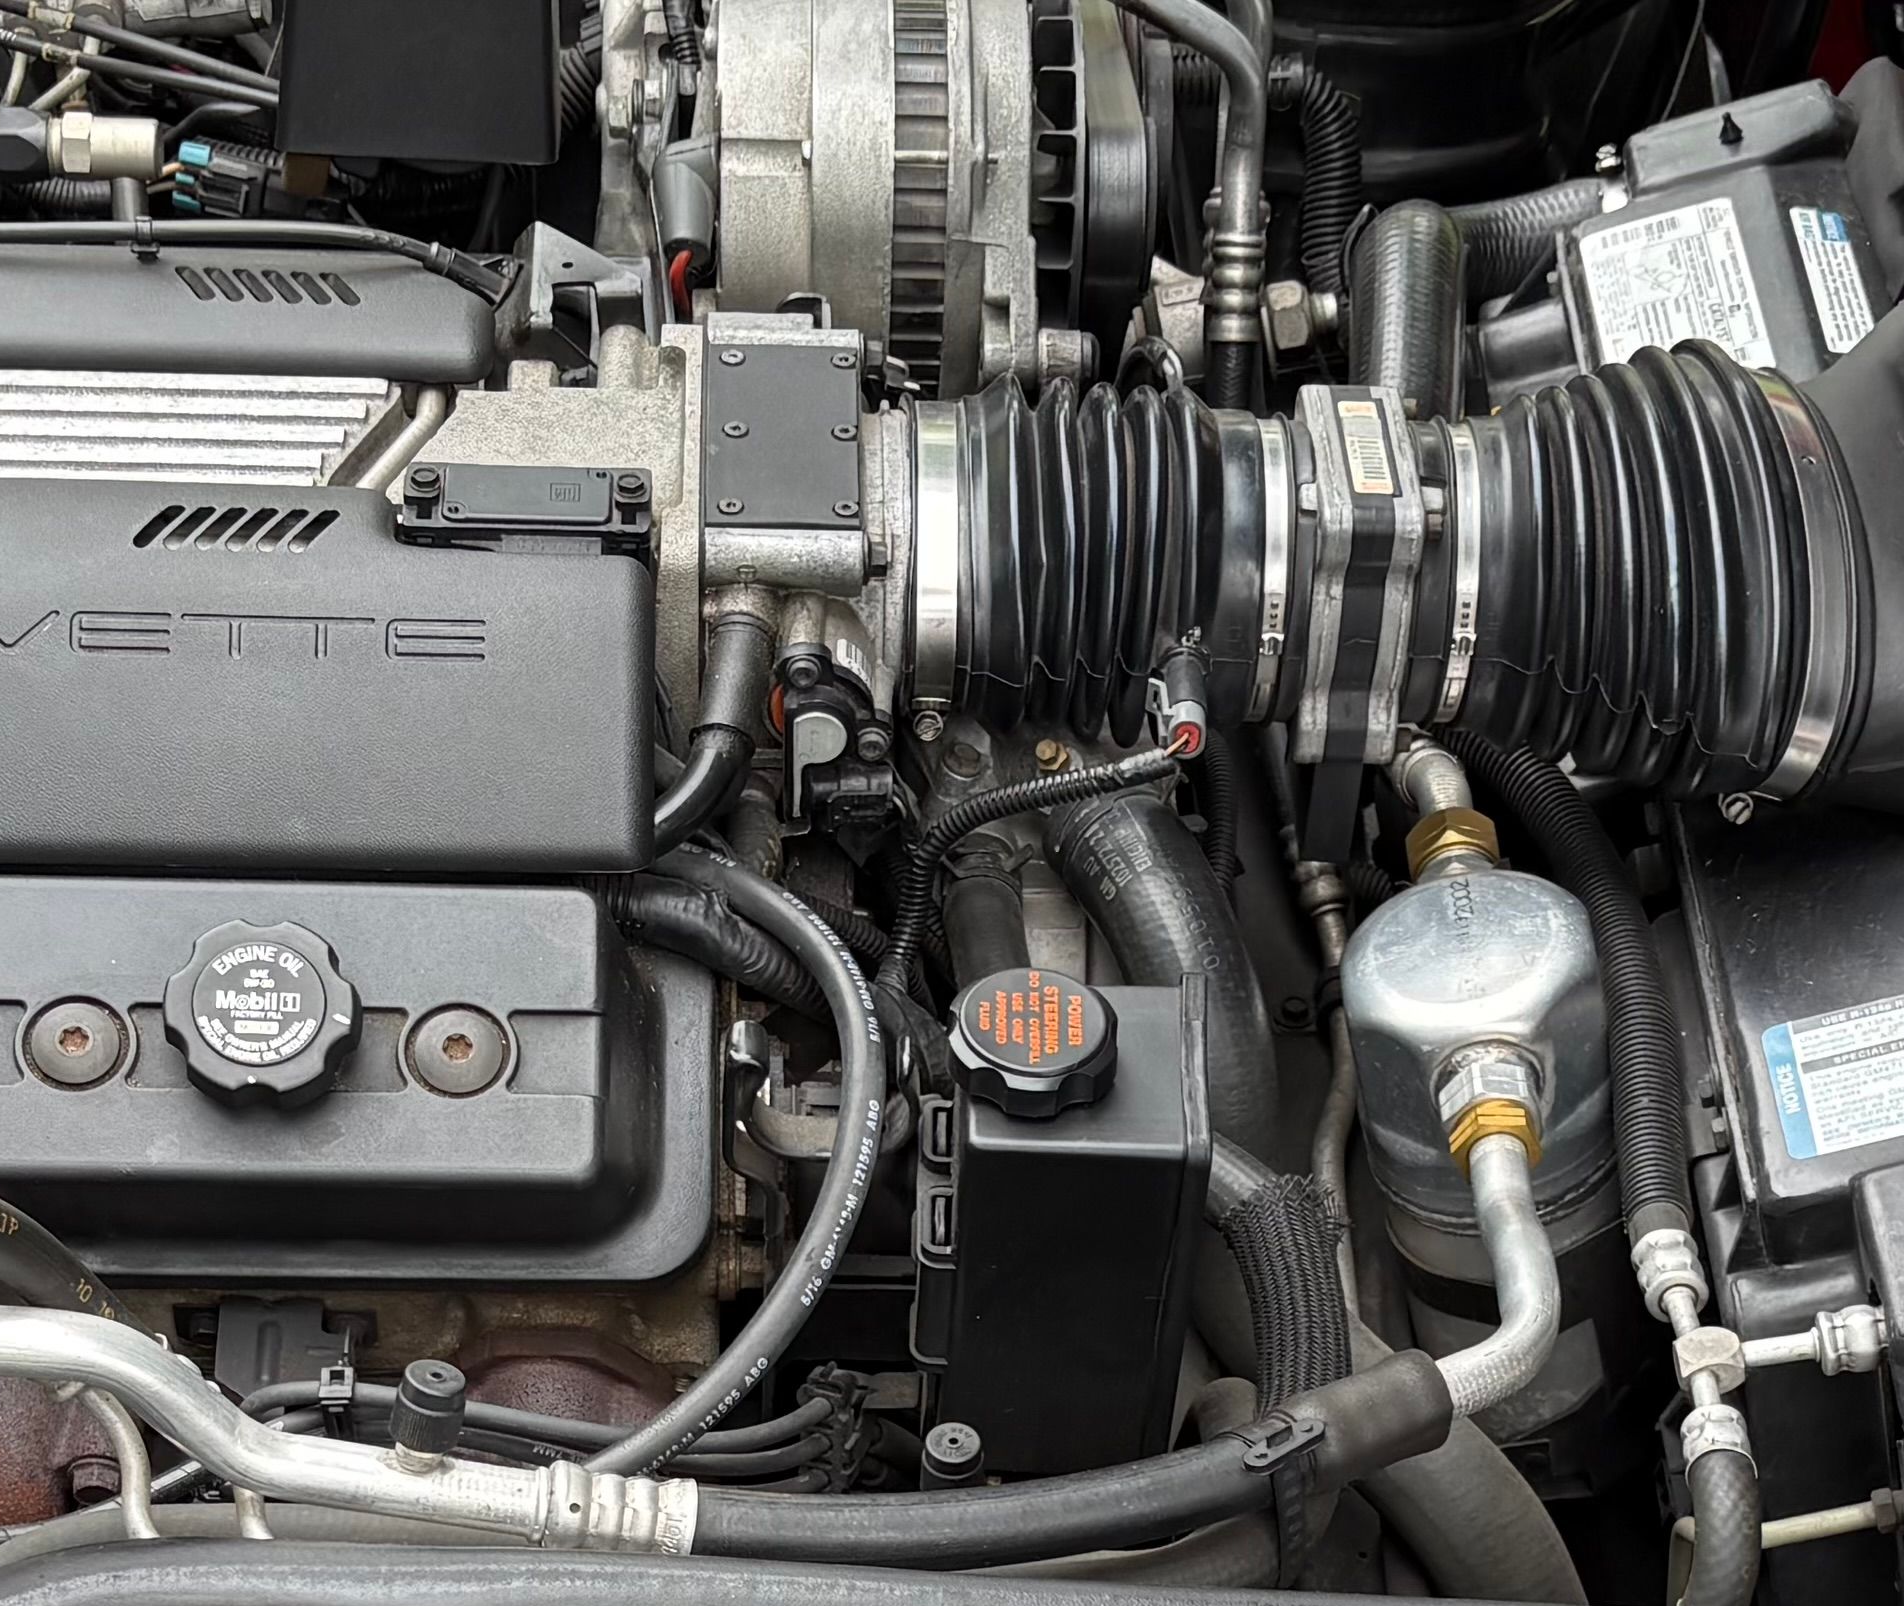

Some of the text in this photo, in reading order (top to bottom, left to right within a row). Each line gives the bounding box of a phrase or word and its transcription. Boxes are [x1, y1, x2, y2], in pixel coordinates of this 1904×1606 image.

[212, 944, 304, 977] ENGINE OIL
[215, 990, 276, 1009] Mobil
[979, 1000, 990, 1031] FLUID
[995, 989, 1006, 1045] APPROVED
[1011, 991, 1023, 1045] USE ONLY
[1028, 970, 1039, 1065] DO NOT OVERFILL
[1043, 984, 1058, 1055] STEERING
[1069, 993, 1083, 1047] POWER
[1821, 1012, 1846, 1026] USE
[1833, 1046, 1882, 1065] SPECIAL
[1775, 1062, 1801, 1115] NOTICE
[851, 1137, 873, 1185] 121595
